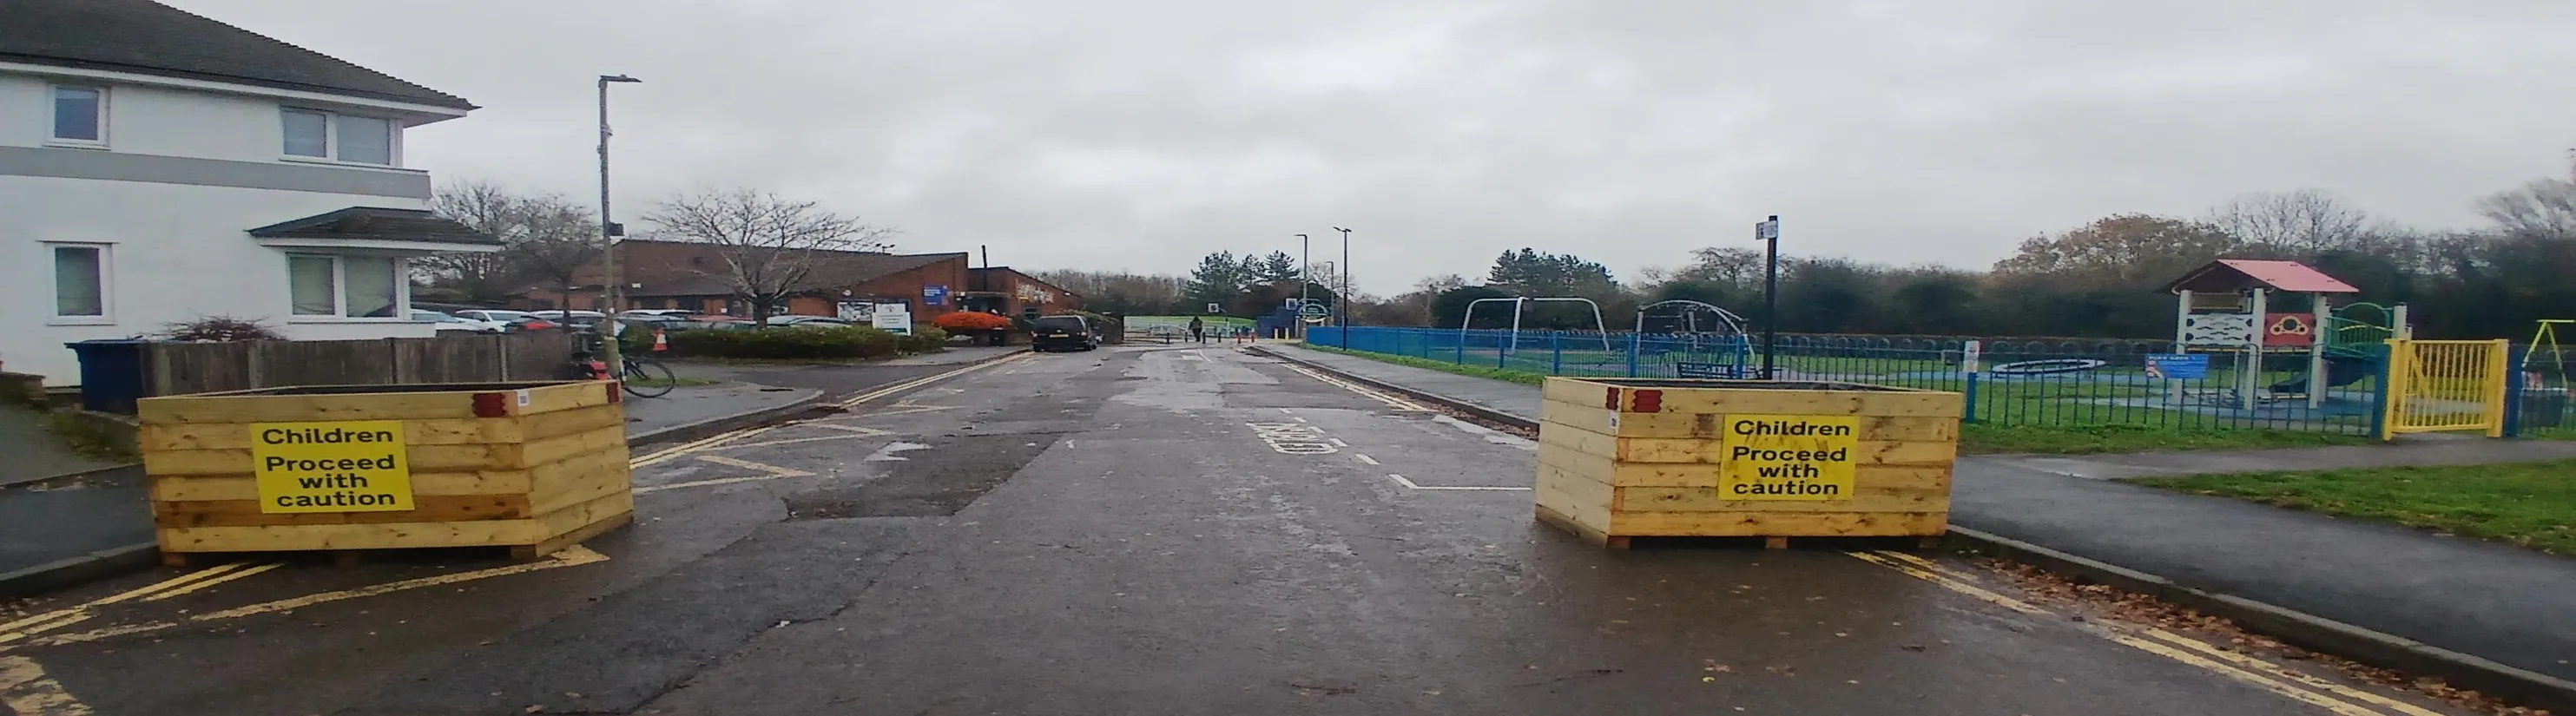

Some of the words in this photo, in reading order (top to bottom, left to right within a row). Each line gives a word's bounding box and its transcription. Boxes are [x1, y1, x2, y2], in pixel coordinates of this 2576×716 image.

[262, 428, 393, 444] Children
[1734, 420, 1850, 436] Children
[1732, 446, 1847, 462] Proceed
[266, 454, 396, 471] Proceed
[1758, 463, 1819, 478] with
[299, 473, 368, 489] with
[1733, 480, 1838, 495] caution
[277, 490, 396, 507] caution
